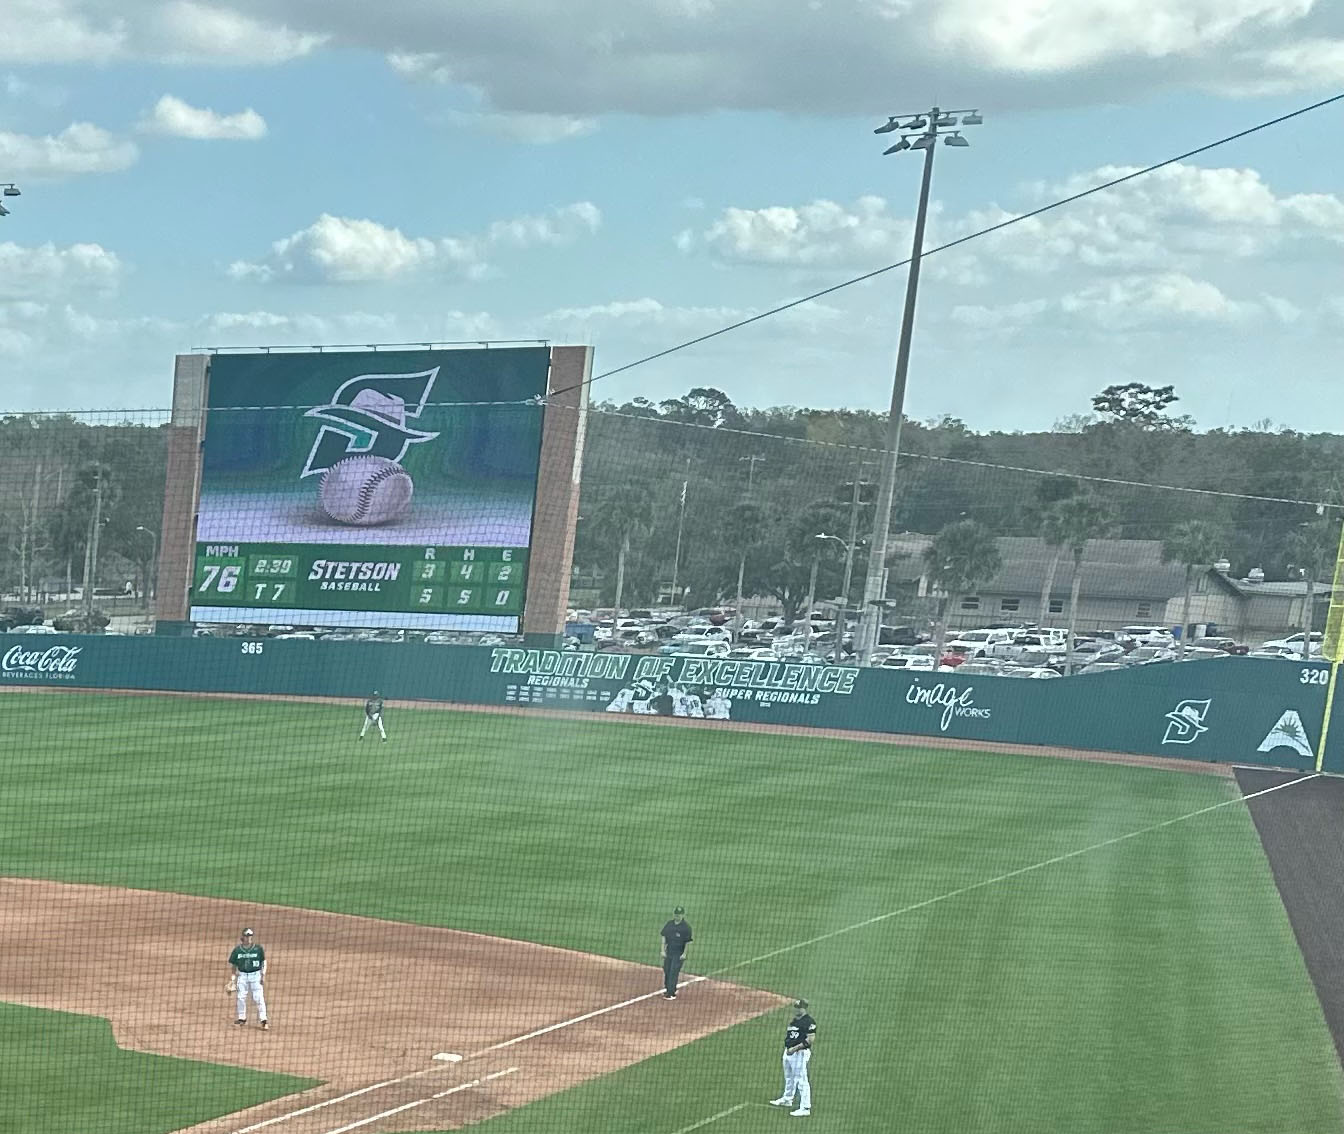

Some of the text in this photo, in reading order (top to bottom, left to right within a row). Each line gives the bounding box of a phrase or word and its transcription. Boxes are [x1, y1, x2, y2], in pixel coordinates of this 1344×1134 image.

[205, 545, 239, 557] MPH
[424, 547, 512, 561] R H E
[199, 565, 241, 592] 76
[308, 559, 402, 581] STETSON
[460, 564, 473, 579] 4
[497, 565, 512, 580] 2
[255, 583, 285, 600] T 7
[320, 581, 381, 592] BASEBALL
[419, 588, 510, 605] 5 5 0
[241, 641, 264, 654] 365
[1, 645, 84, 672] Coca-Cola
[490, 648, 861, 694] TRADITION OF EXCELLENCE
[1299, 668, 1329, 685] 320
[527, 674, 590, 688] REGIONALS
[715, 687, 753, 701] SUPER
[756, 691, 821, 705] REGIONALS
[905, 677, 974, 731] image
[954, 706, 991, 718] WORKS
